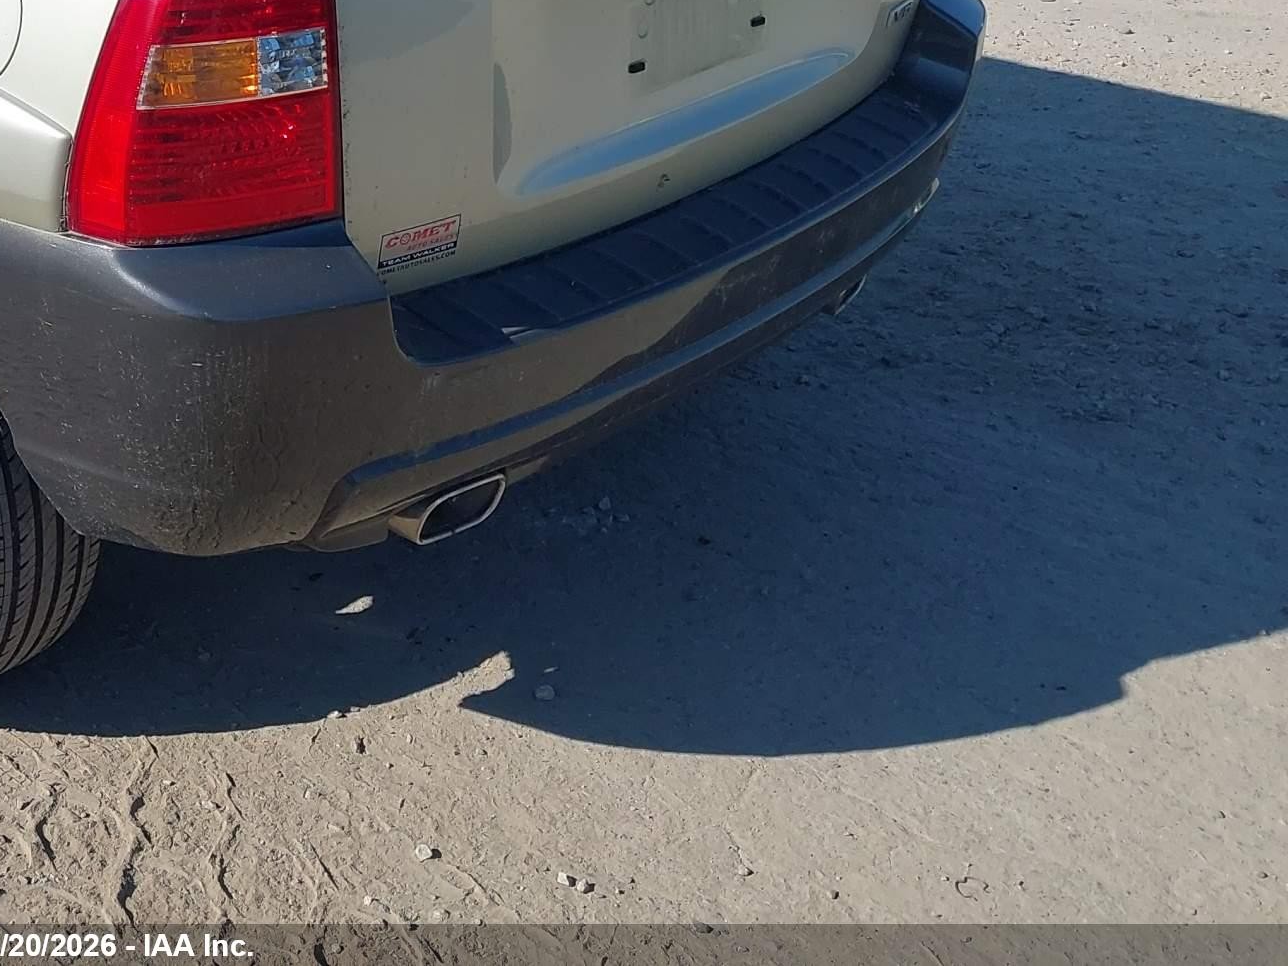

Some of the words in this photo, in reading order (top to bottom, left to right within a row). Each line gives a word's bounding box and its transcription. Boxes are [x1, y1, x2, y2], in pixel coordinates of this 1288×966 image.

[385, 220, 457, 250] COMET
[382, 254, 412, 266] TEAM
[413, 242, 455, 259] WALKER
